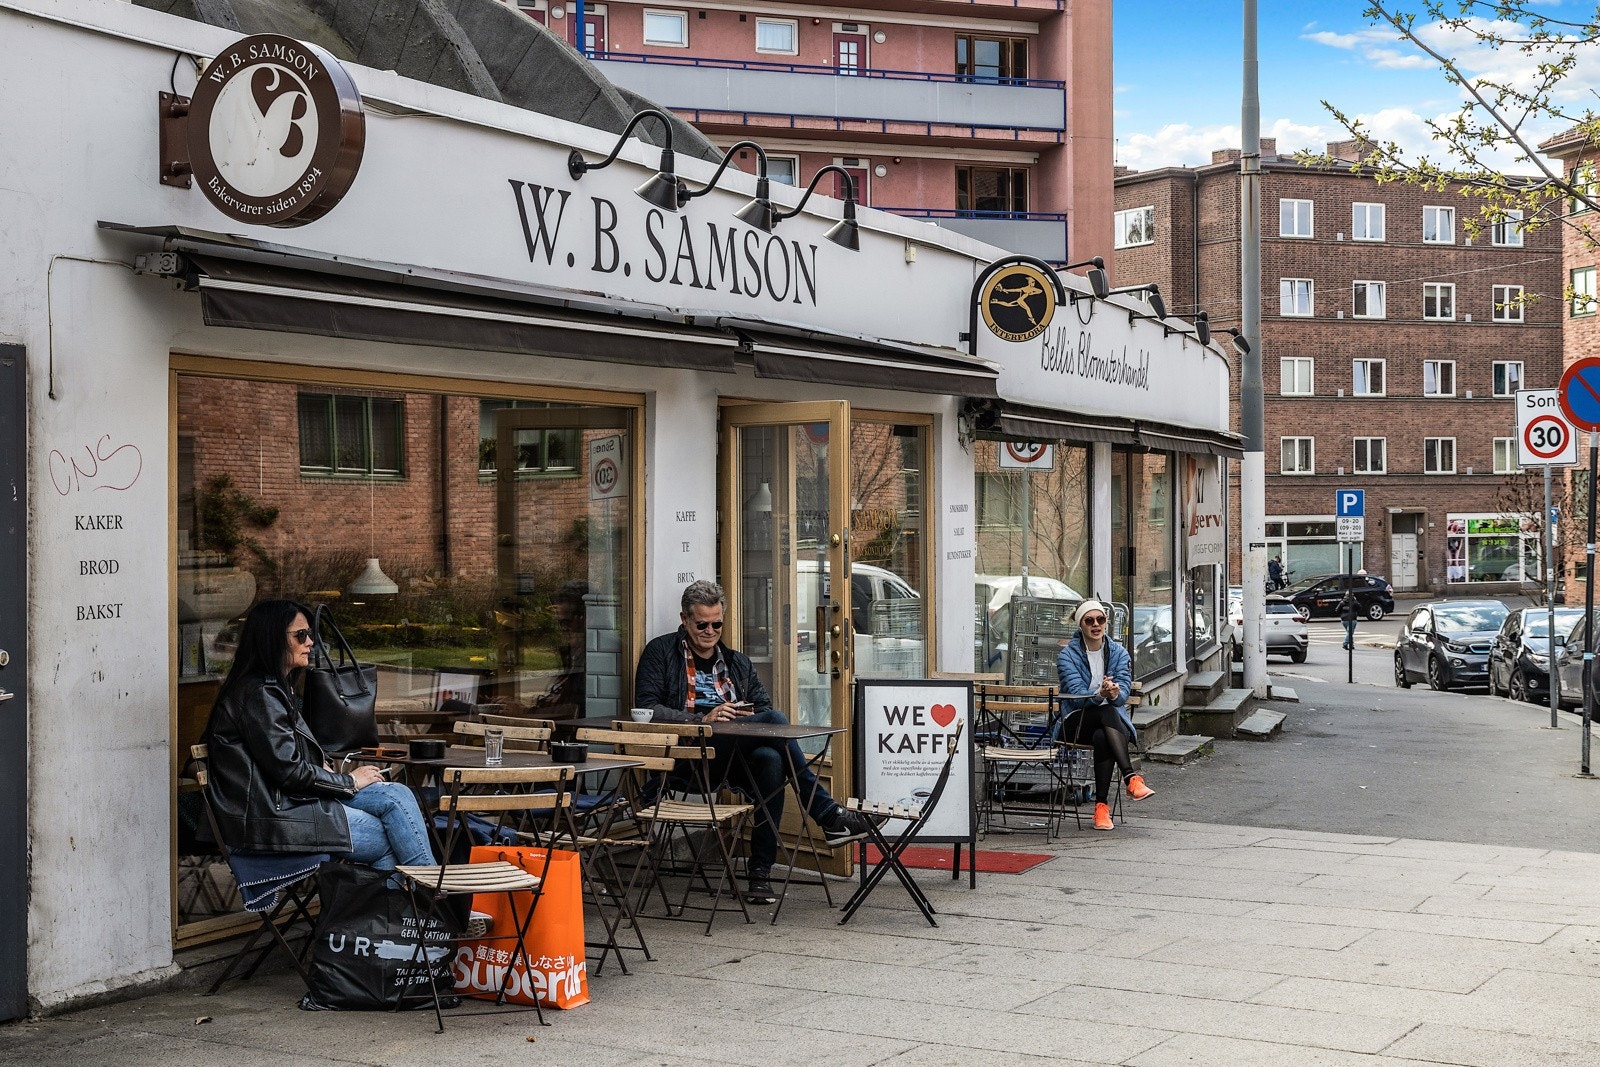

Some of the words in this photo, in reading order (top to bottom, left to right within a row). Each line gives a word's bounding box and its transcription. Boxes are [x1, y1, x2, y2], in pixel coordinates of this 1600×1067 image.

[209, 66, 231, 85] W.
[230, 53, 247, 68] B.
[248, 43, 319, 82] SAMSON
[207, 175, 264, 216] Bakervarer
[266, 196, 297, 215] siden
[297, 166, 323, 198] 1894
[507, 179, 576, 268] W.
[591, 197, 632, 277] B.
[645, 208, 818, 308] SAMSON
[990, 322, 1046, 342] INTERFLORA
[1041, 326, 1075, 375] Bellis
[1077, 330, 1150, 391] Blomsterhandel
[1526, 395, 1556, 409] Son
[1533, 426, 1562, 448] 30
[1343, 493, 1358, 514] P
[75, 515, 123, 531] KAKER
[676, 511, 696, 522] KAFFE
[681, 542, 690, 552] TE
[79, 559, 120, 576] BRØD
[677, 572, 695, 583] BRUS
[76, 603, 123, 621] BAKST
[883, 705, 926, 727] WE
[402, 917, 416, 927] THE
[419, 918, 438, 928] NW
[394, 977, 413, 986] SAE
[453, 946, 587, 1003] Superdr
